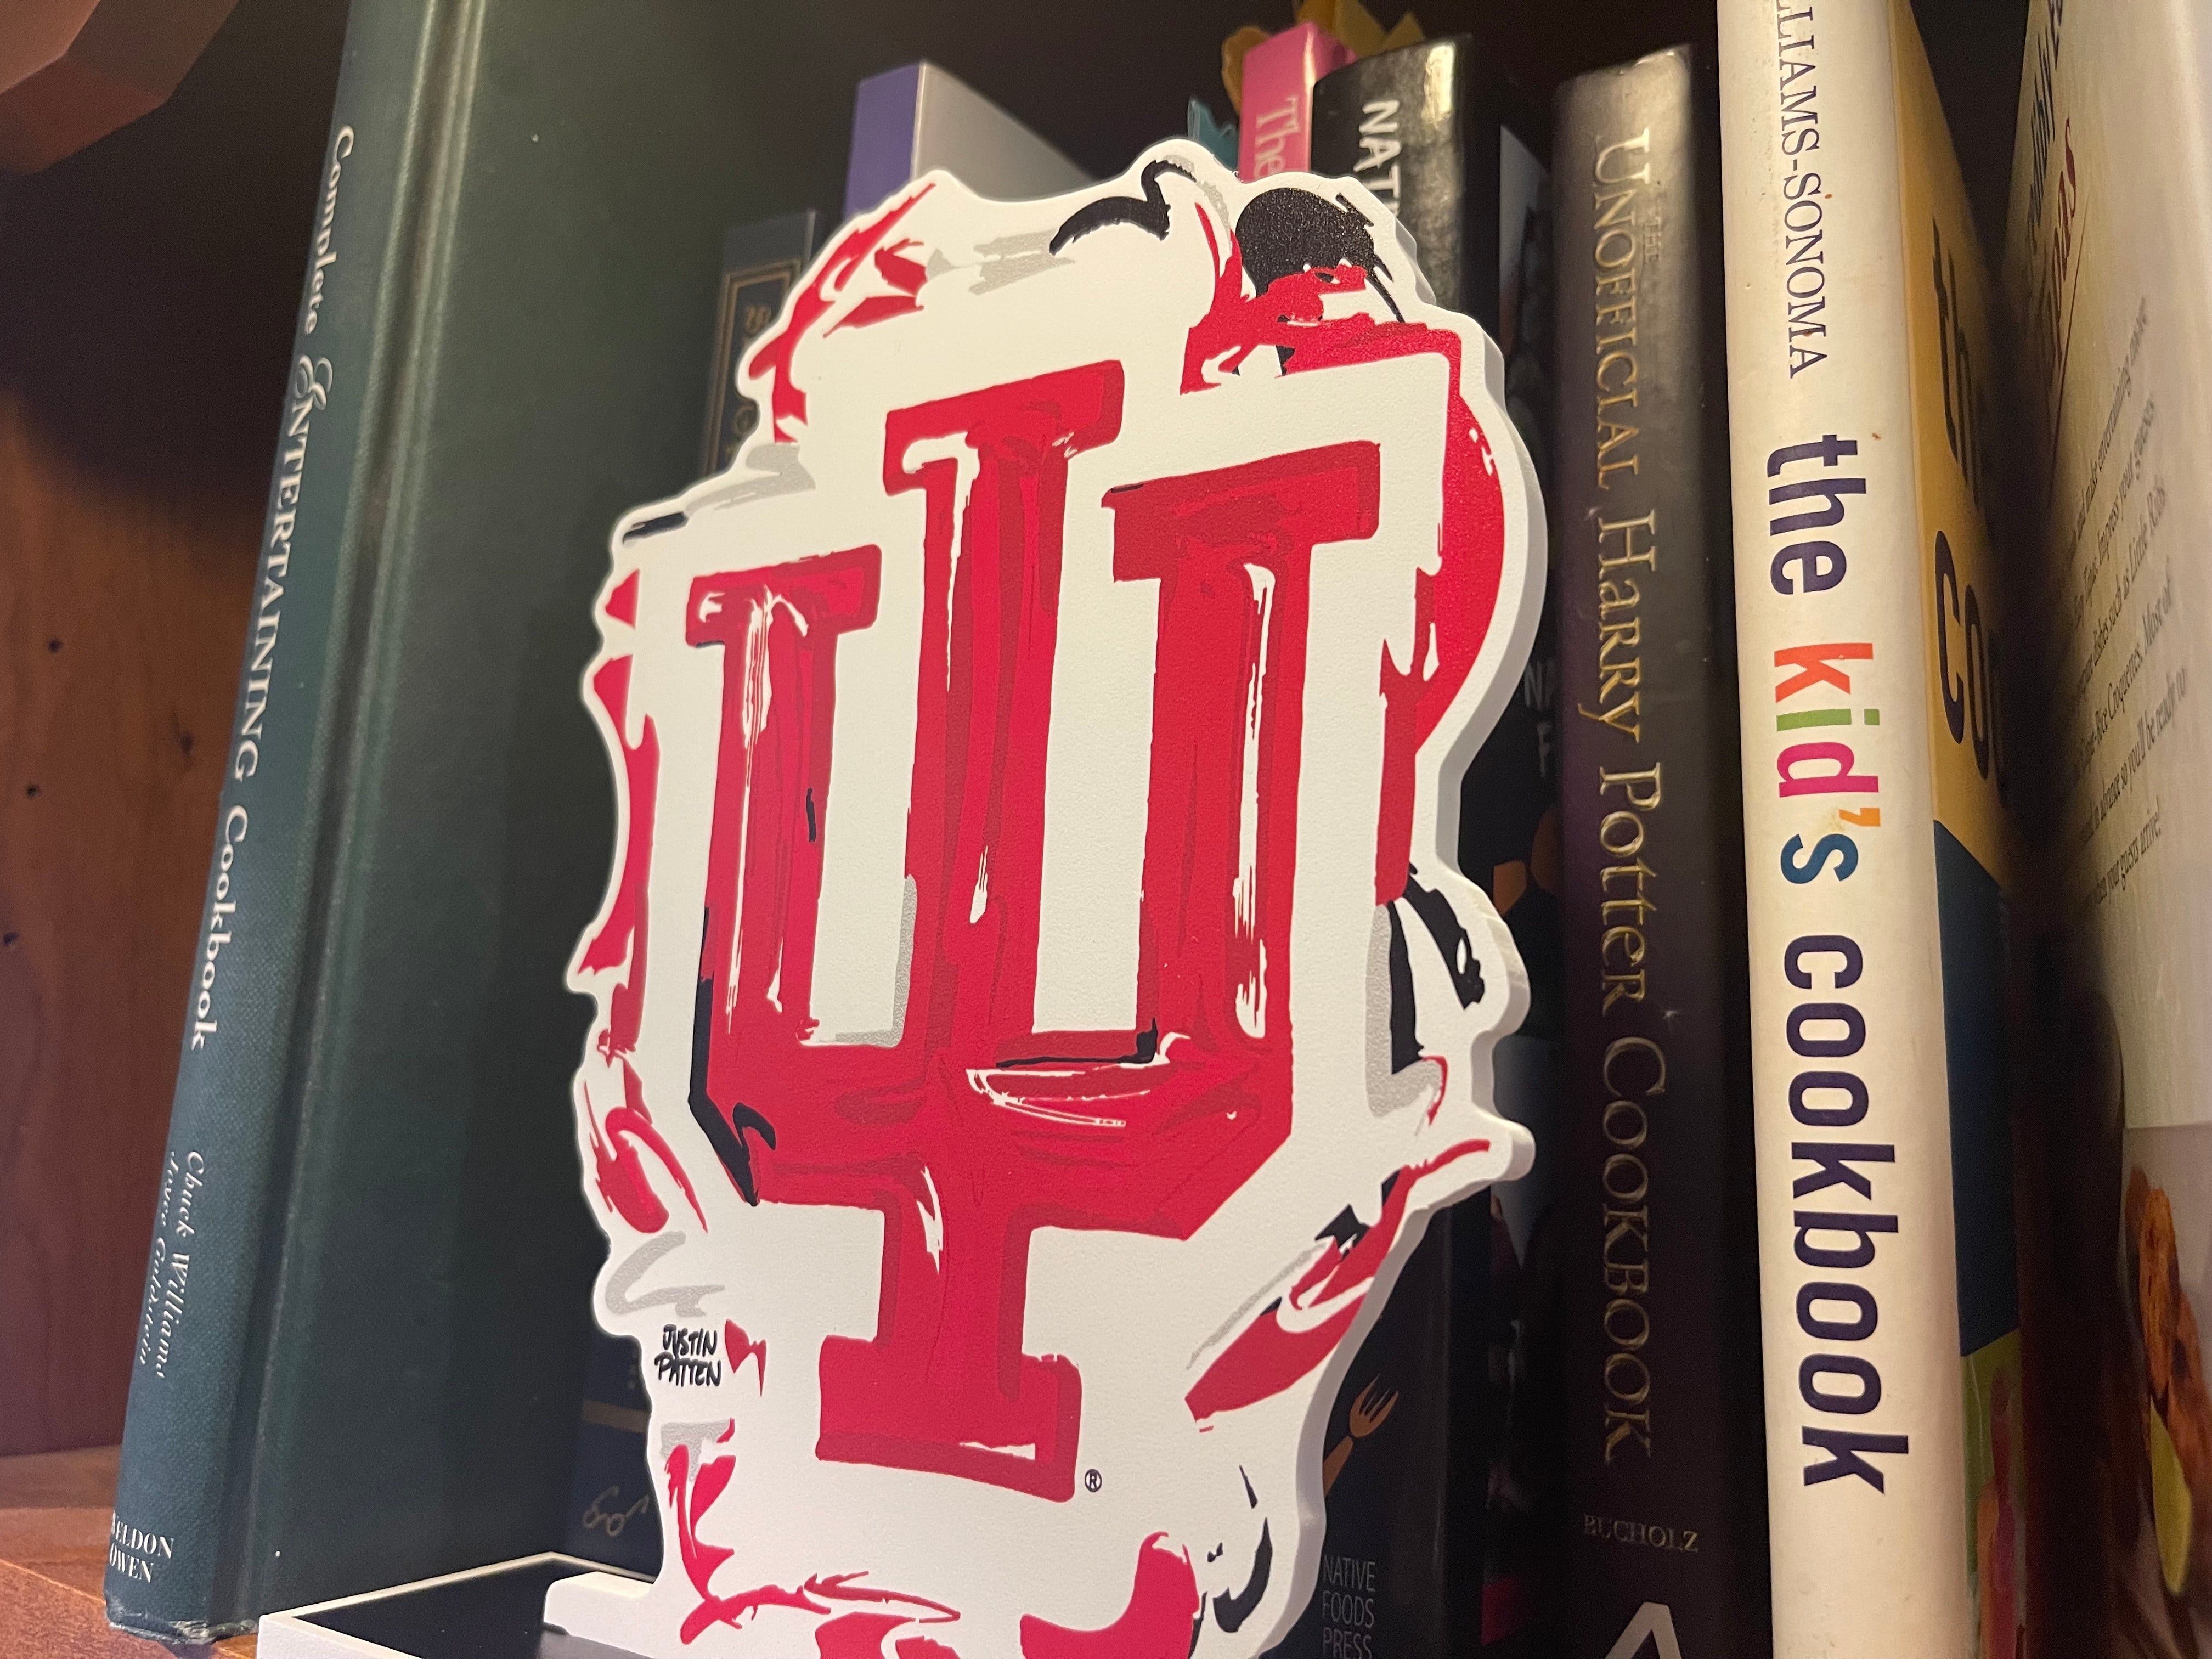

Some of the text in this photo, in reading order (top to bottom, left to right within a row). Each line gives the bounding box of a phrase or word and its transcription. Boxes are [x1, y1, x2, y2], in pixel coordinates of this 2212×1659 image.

[1254, 95, 1300, 179] The
[1594, 126, 1650, 490] UNOFFICIAL
[191, 126, 354, 1051] Complete ENTERTAINING Cookbook
[1767, 434, 1909, 1494] the kid's cookbook
[156, 1151, 205, 1379] Chuck Williams
[1602, 1035, 1667, 1466] COOKBOOK
[662, 1323, 718, 1356] JUSTIN
[654, 1351, 721, 1387] PATTEN
[1584, 1513, 1699, 1553] BUCHOLZ
[110, 1542, 154, 1584] OWEN
[1322, 1554, 1376, 1592] NATIVE
[1322, 1590, 1375, 1629] FOODS
[1322, 1626, 1373, 1659] PRESS
